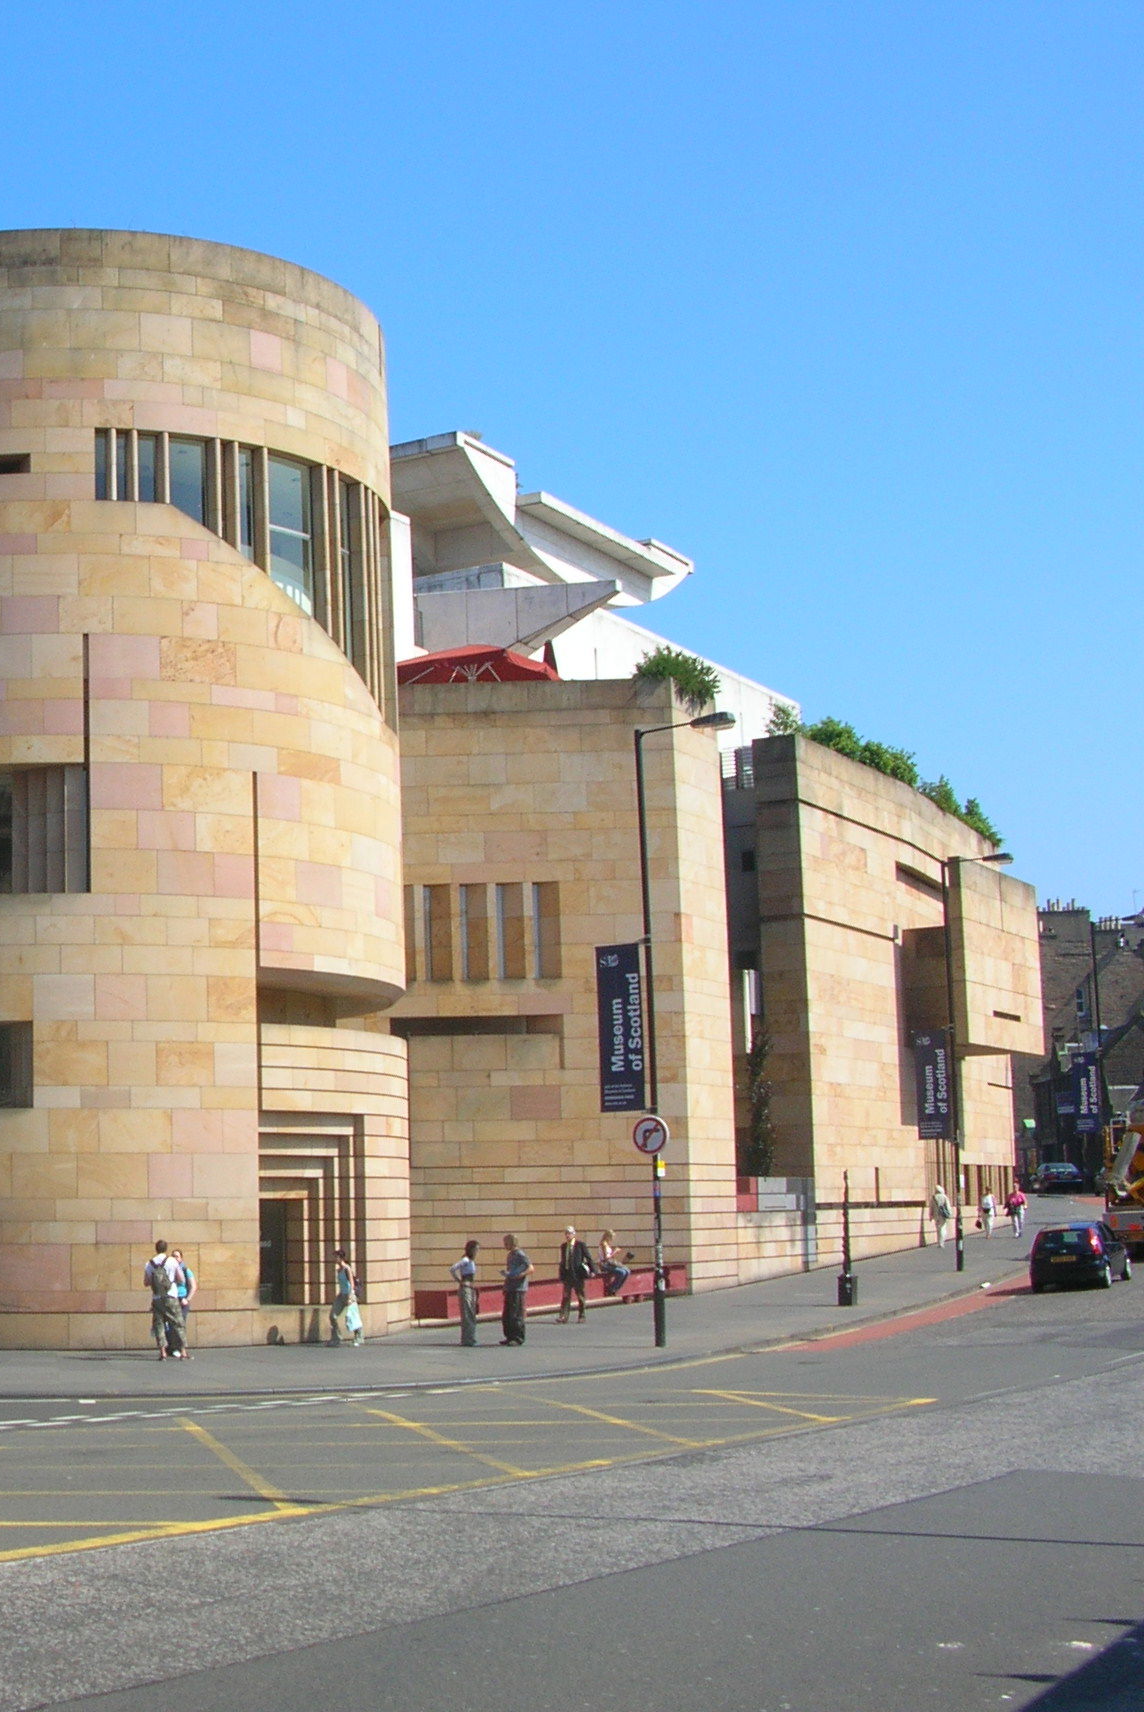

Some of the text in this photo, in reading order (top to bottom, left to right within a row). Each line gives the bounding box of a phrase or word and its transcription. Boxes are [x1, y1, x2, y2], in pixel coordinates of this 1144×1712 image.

[611, 998, 625, 1073] Museum
[625, 972, 643, 1072] of Scotland
[924, 1065, 935, 1114] Museum
[934, 1048, 948, 1114] of Scotland
[1080, 1077, 1088, 1114] Museum
[1088, 1065, 1098, 1103] Scotland
